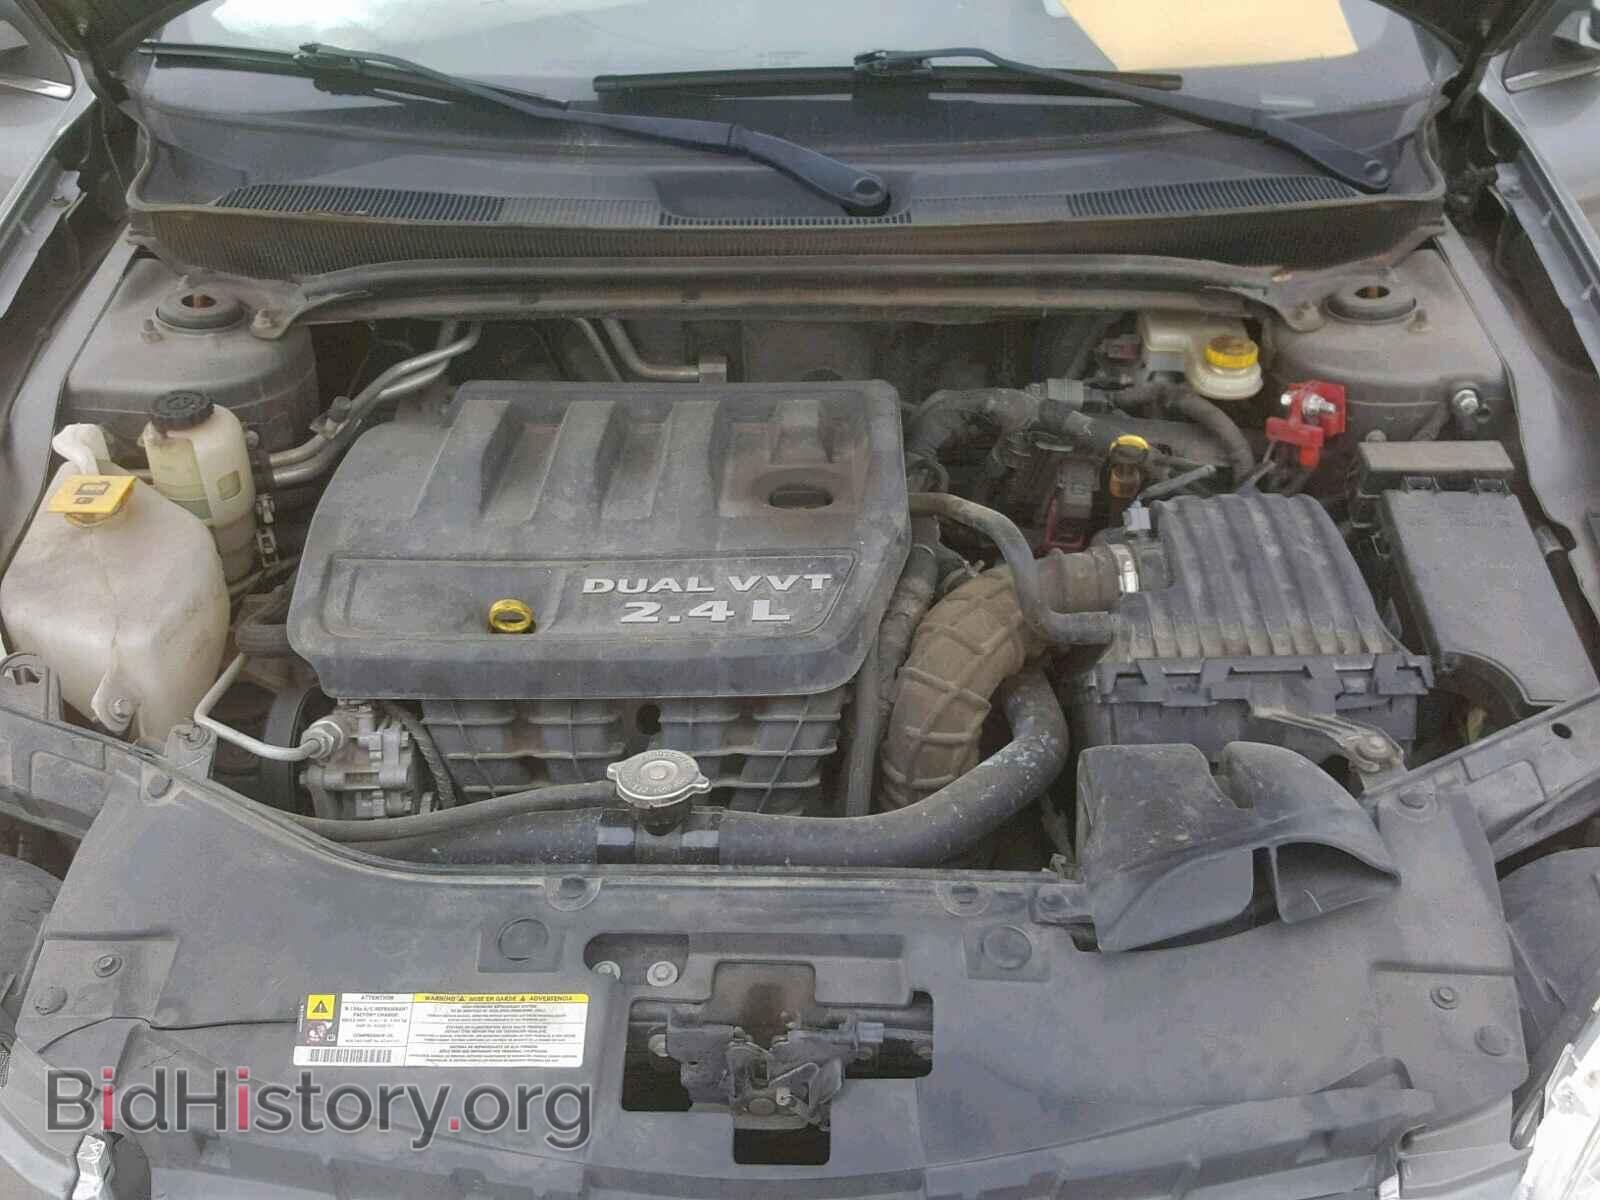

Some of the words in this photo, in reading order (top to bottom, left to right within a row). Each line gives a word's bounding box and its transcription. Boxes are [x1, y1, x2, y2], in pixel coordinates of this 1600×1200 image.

[582, 576, 716, 595] DUAL
[727, 573, 833, 592] VVT
[619, 599, 737, 624] 2.4
[751, 599, 792, 622] L
